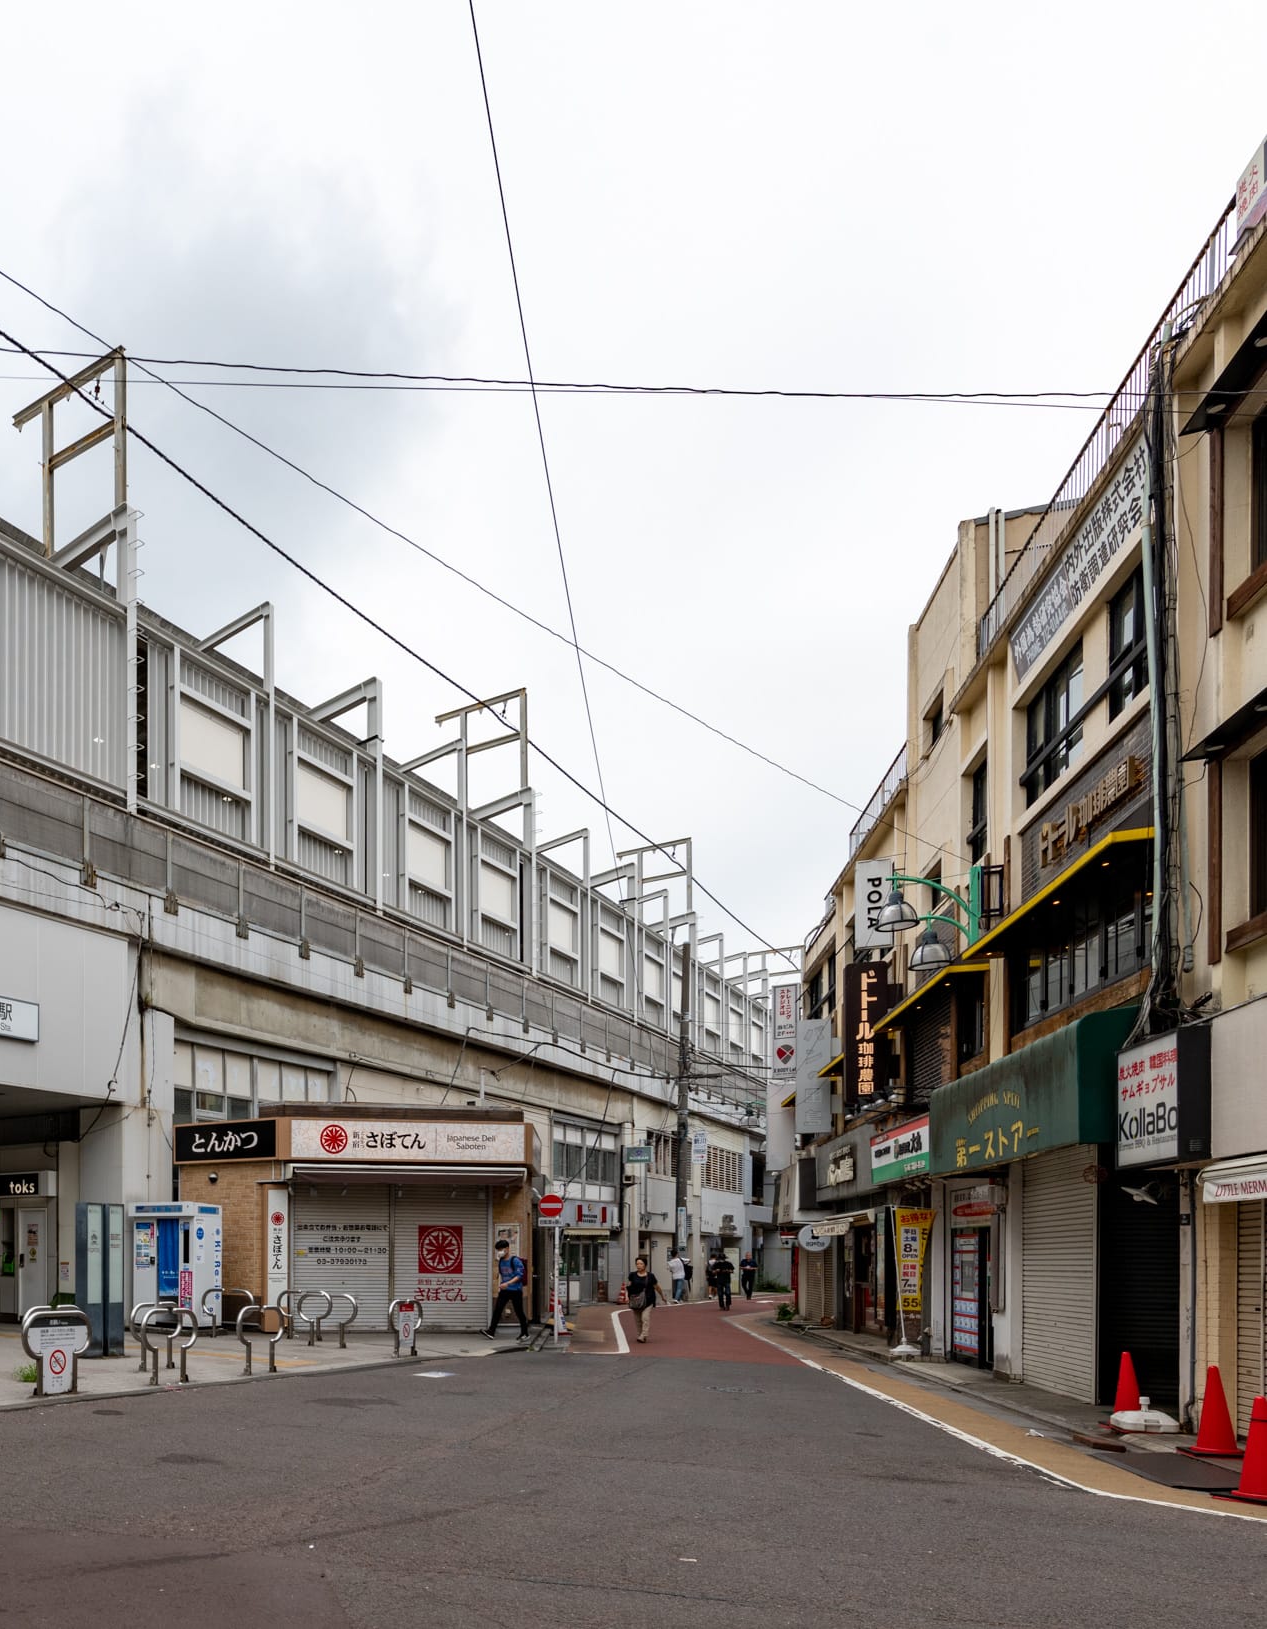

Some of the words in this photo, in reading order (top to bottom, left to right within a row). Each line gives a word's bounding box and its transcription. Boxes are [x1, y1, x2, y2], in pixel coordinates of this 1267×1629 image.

[1064, 446, 1147, 582] 内外出版株式会社
[1071, 484, 1145, 607] 防衛調達研究会
[866, 876, 882, 929] POLA
[0, 1022, 13, 1033] Sta.
[855, 969, 878, 1095] ドトール珈琲農園
[1118, 1058, 1145, 1081] 炭火焼肉
[1120, 1071, 1176, 1102] サムギョプサル
[1118, 1101, 1178, 1142] KollaBo
[190, 1131, 259, 1154] とんかつ
[352, 1131, 360, 1149] 新宿
[365, 1129, 426, 1150] さぼてん
[446, 1133, 480, 1145] Japanese
[481, 1133, 496, 1144] Deli
[456, 1142, 486, 1152] Saboten
[955, 1120, 1040, 1168] 第一ストアー
[9, 1179, 35, 1195] toks
[1215, 1182, 1240, 1198] LITTLE
[272, 1234, 283, 1270] さぼてん
[413, 1287, 468, 1302] さぼてん
